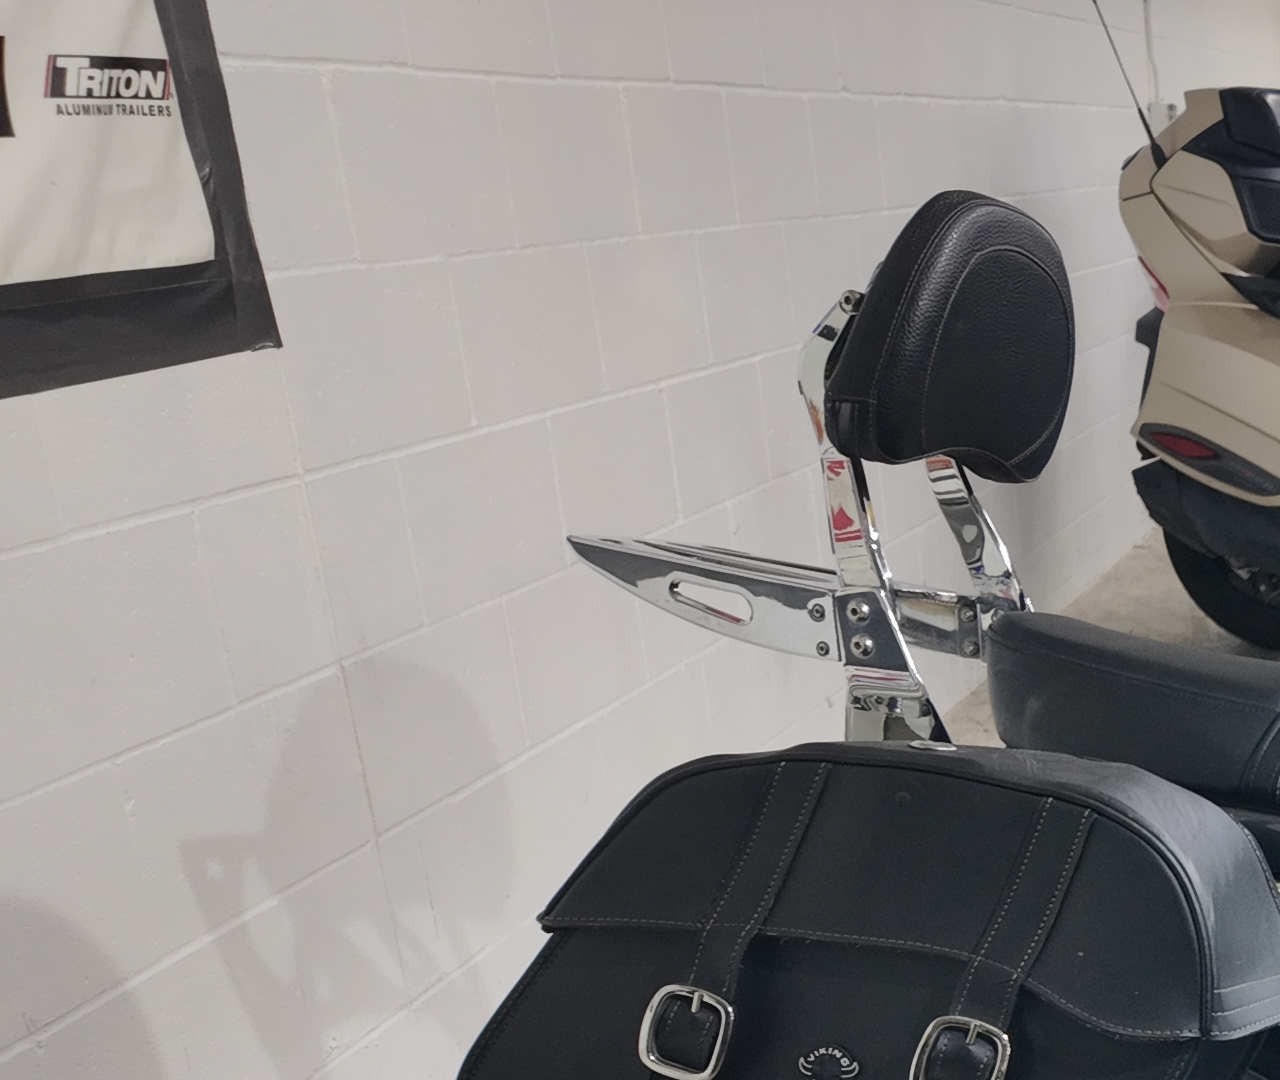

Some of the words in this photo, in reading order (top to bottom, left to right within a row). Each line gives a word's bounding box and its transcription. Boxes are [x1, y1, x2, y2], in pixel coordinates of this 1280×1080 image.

[56, 56, 166, 99] TRITON
[116, 104, 173, 118] TRAILERS
[806, 1047, 850, 1067] VIKING
